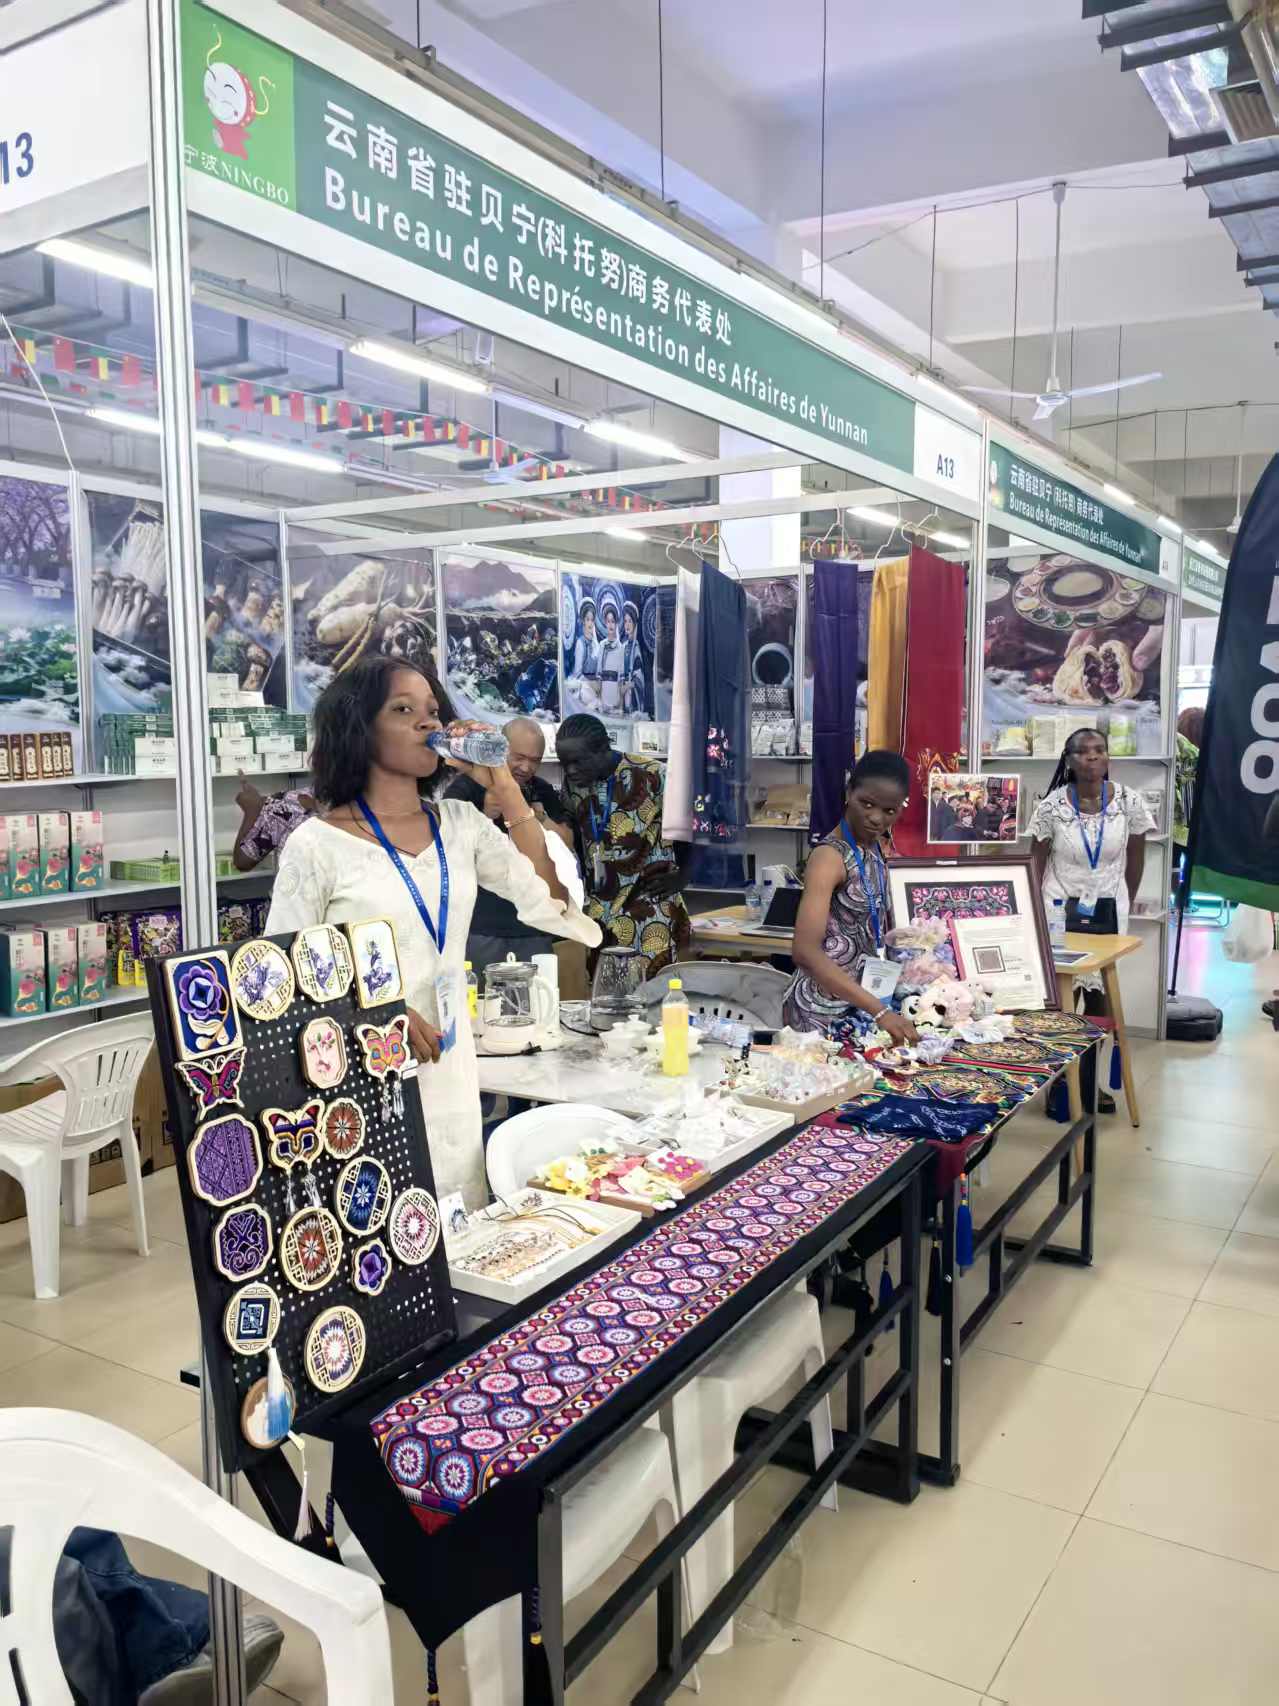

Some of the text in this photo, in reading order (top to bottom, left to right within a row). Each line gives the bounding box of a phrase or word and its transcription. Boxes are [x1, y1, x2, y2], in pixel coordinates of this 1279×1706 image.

[221, 160, 289, 205] NINGBO
[324, 100, 733, 347] 云南省驻贝宁(科托努)商务代表处
[324, 166, 868, 447] Bureau de Représentation des Affaires de Yunnan
[936, 453, 955, 479] A13
[1009, 491, 1035, 519] Bureau
